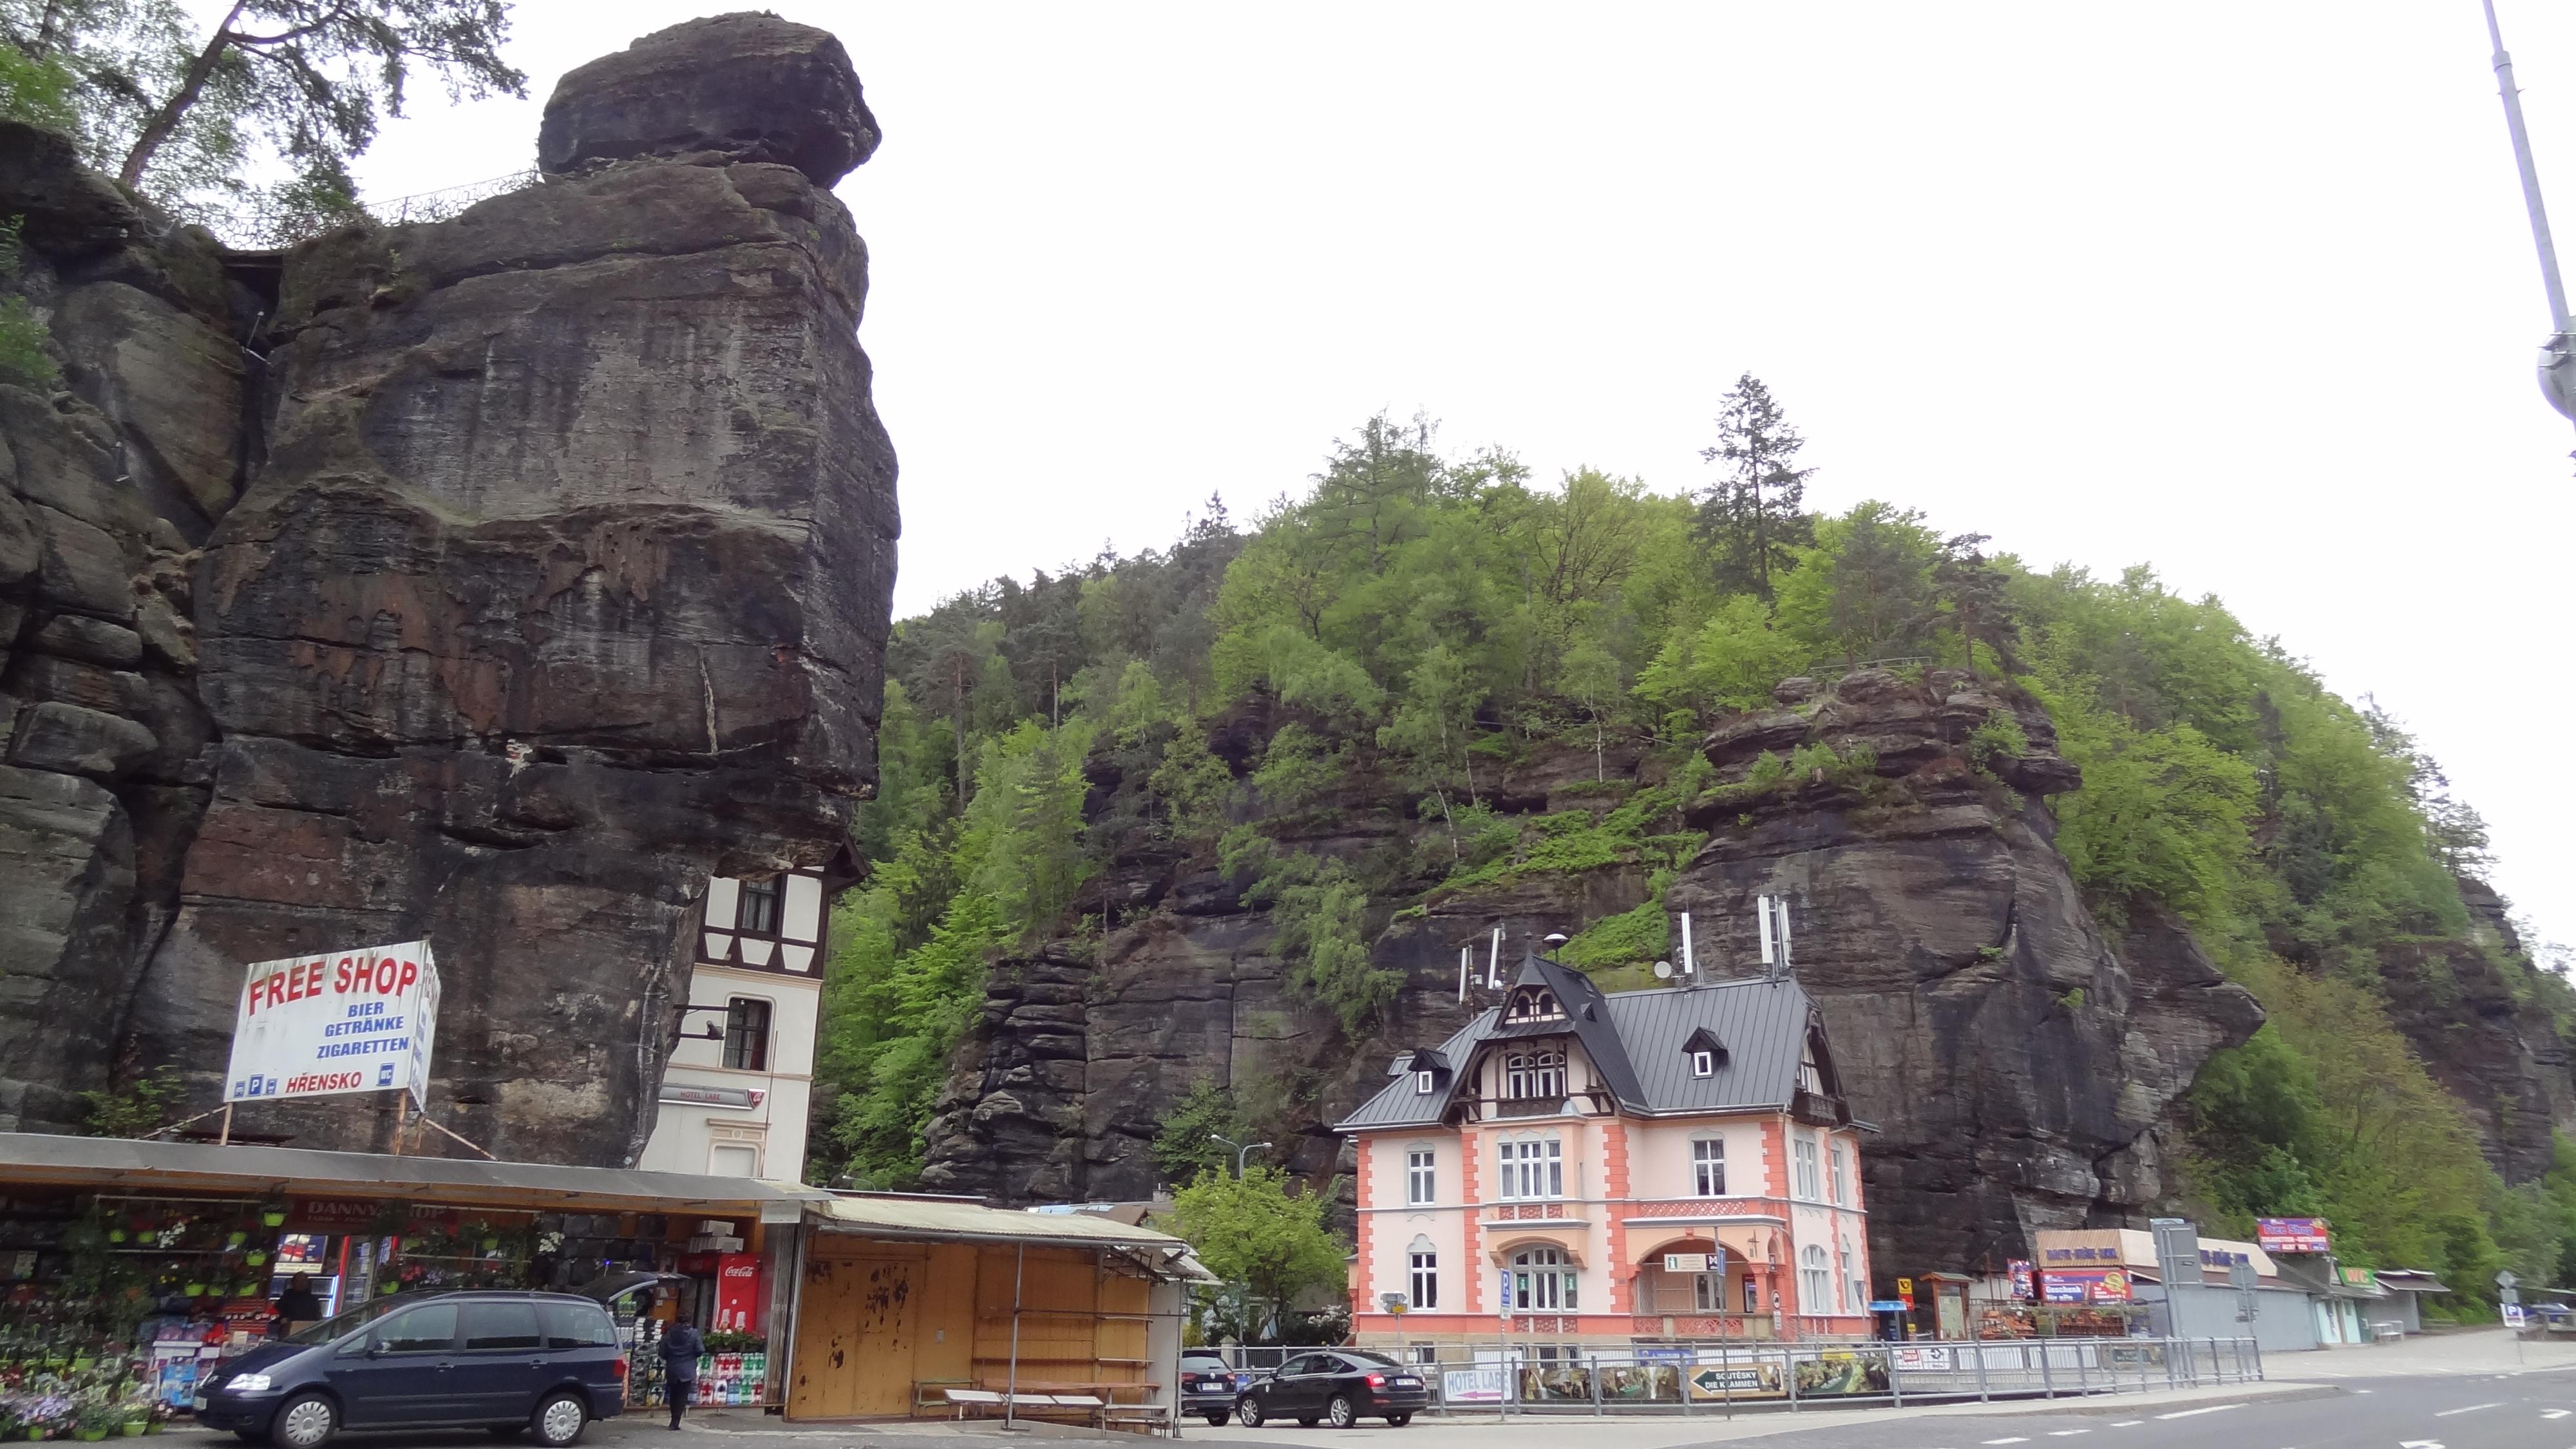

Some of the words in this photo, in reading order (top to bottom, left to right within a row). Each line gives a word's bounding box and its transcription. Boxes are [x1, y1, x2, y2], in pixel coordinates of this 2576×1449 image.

[248, 960, 327, 1016] FREE
[333, 956, 418, 997] SHOP
[347, 1001, 384, 1018] BIER
[324, 1016, 404, 1037] GETRÄNKE
[316, 1037, 410, 1059] ZIGARETTEN
[285, 1072, 363, 1094] HŘENSKO
[2345, 1269, 2369, 1284] WC
[1447, 1372, 1480, 1394] HOTEL
[1705, 1381, 1718, 1389] DIE
[1719, 1380, 1758, 1388] KAMMEN
